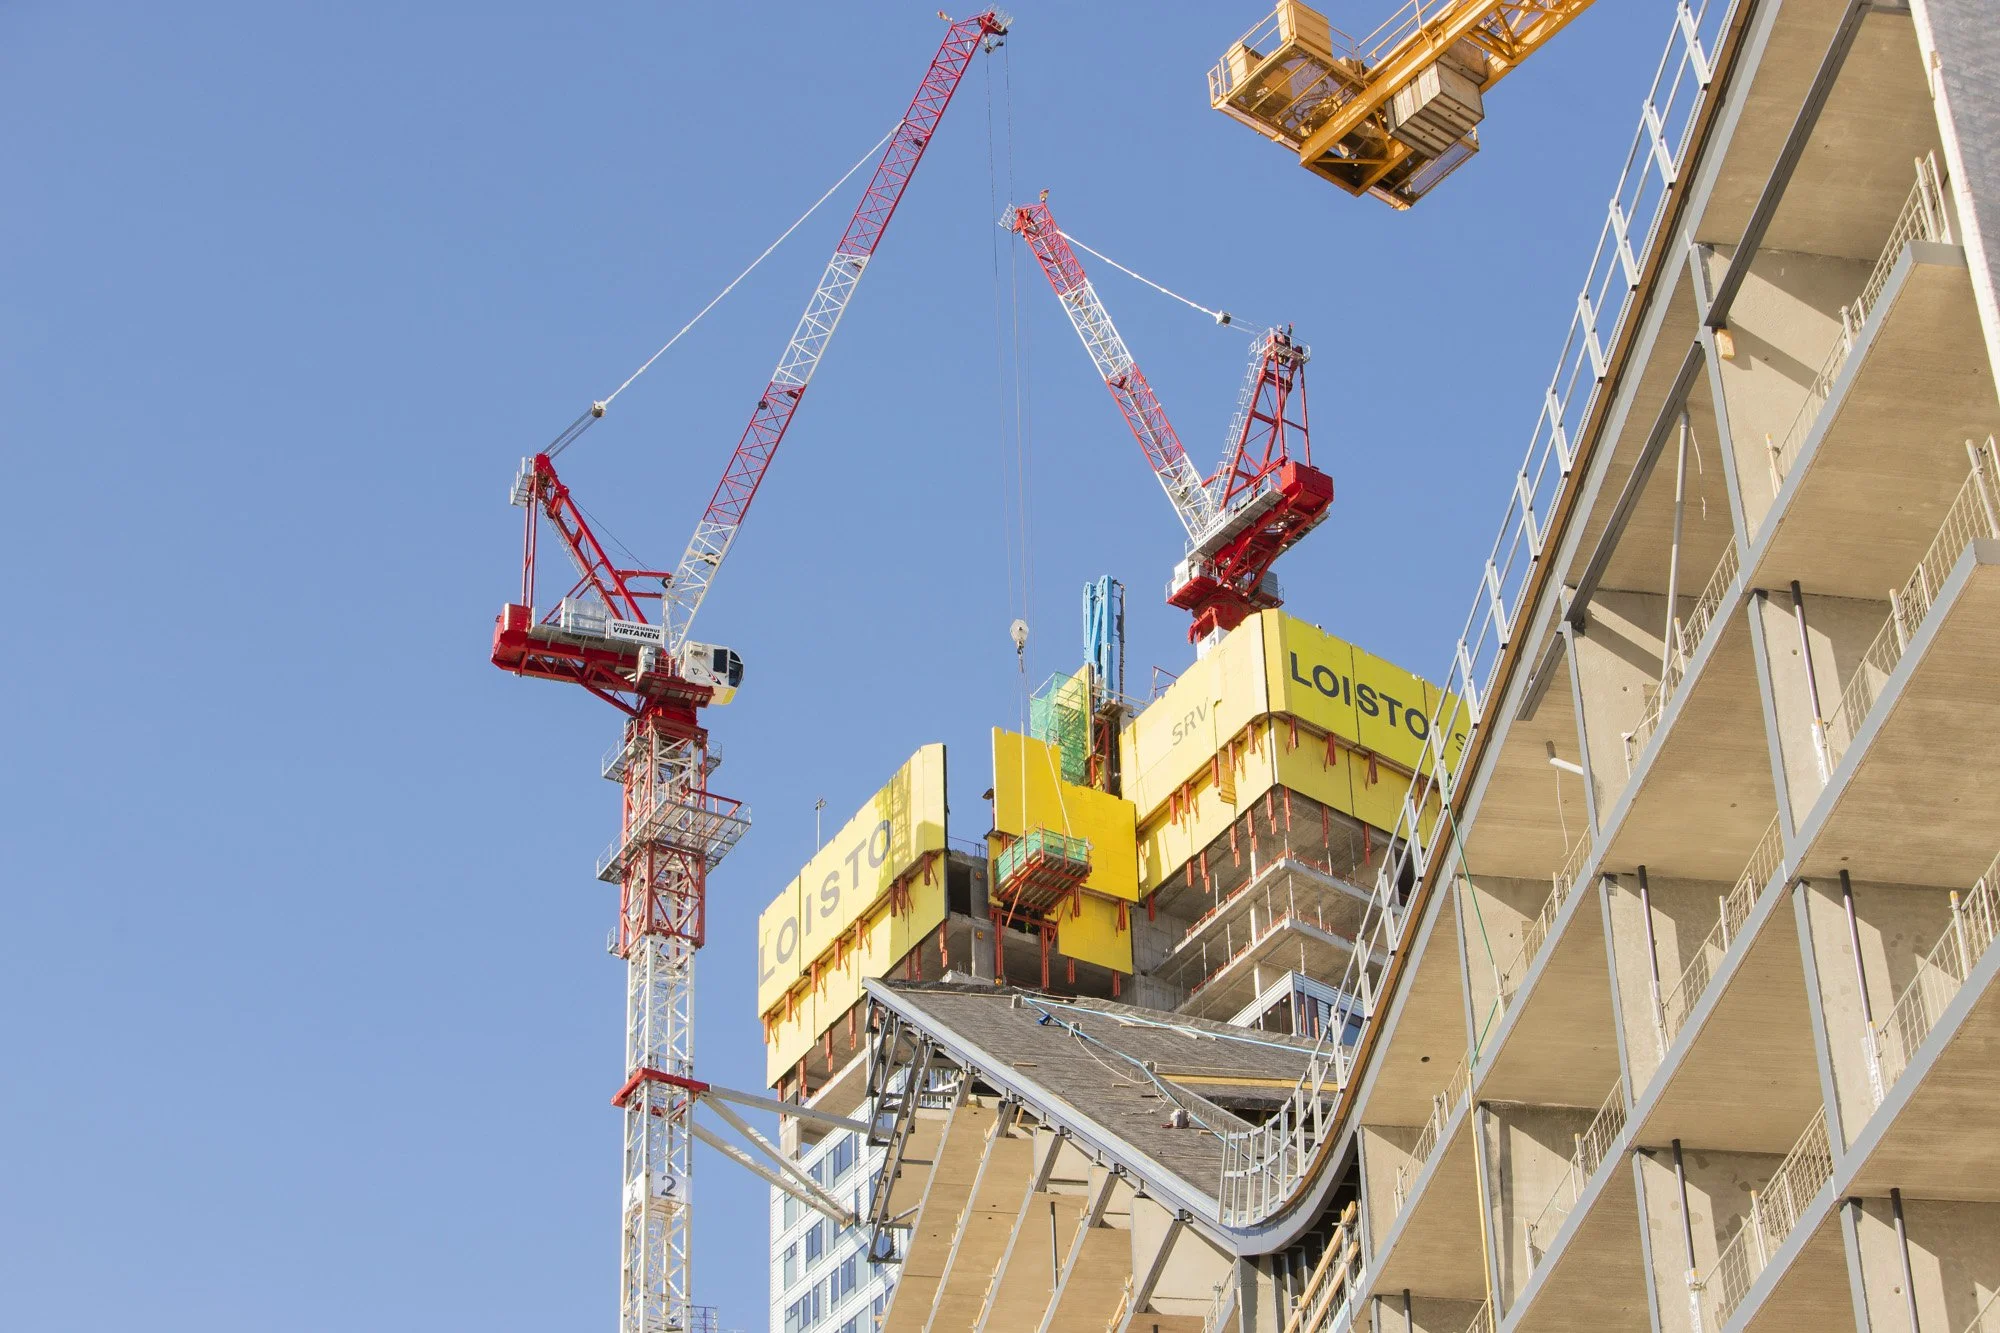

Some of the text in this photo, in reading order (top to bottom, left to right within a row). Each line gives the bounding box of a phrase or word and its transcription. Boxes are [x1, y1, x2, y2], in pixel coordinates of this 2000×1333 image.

[613, 626, 660, 640] VIRTANEN
[1290, 650, 1429, 741] LOISTO
[1172, 696, 1209, 747] SRV
[759, 819, 892, 988] LOISTO
[660, 1175, 677, 1197] 2
